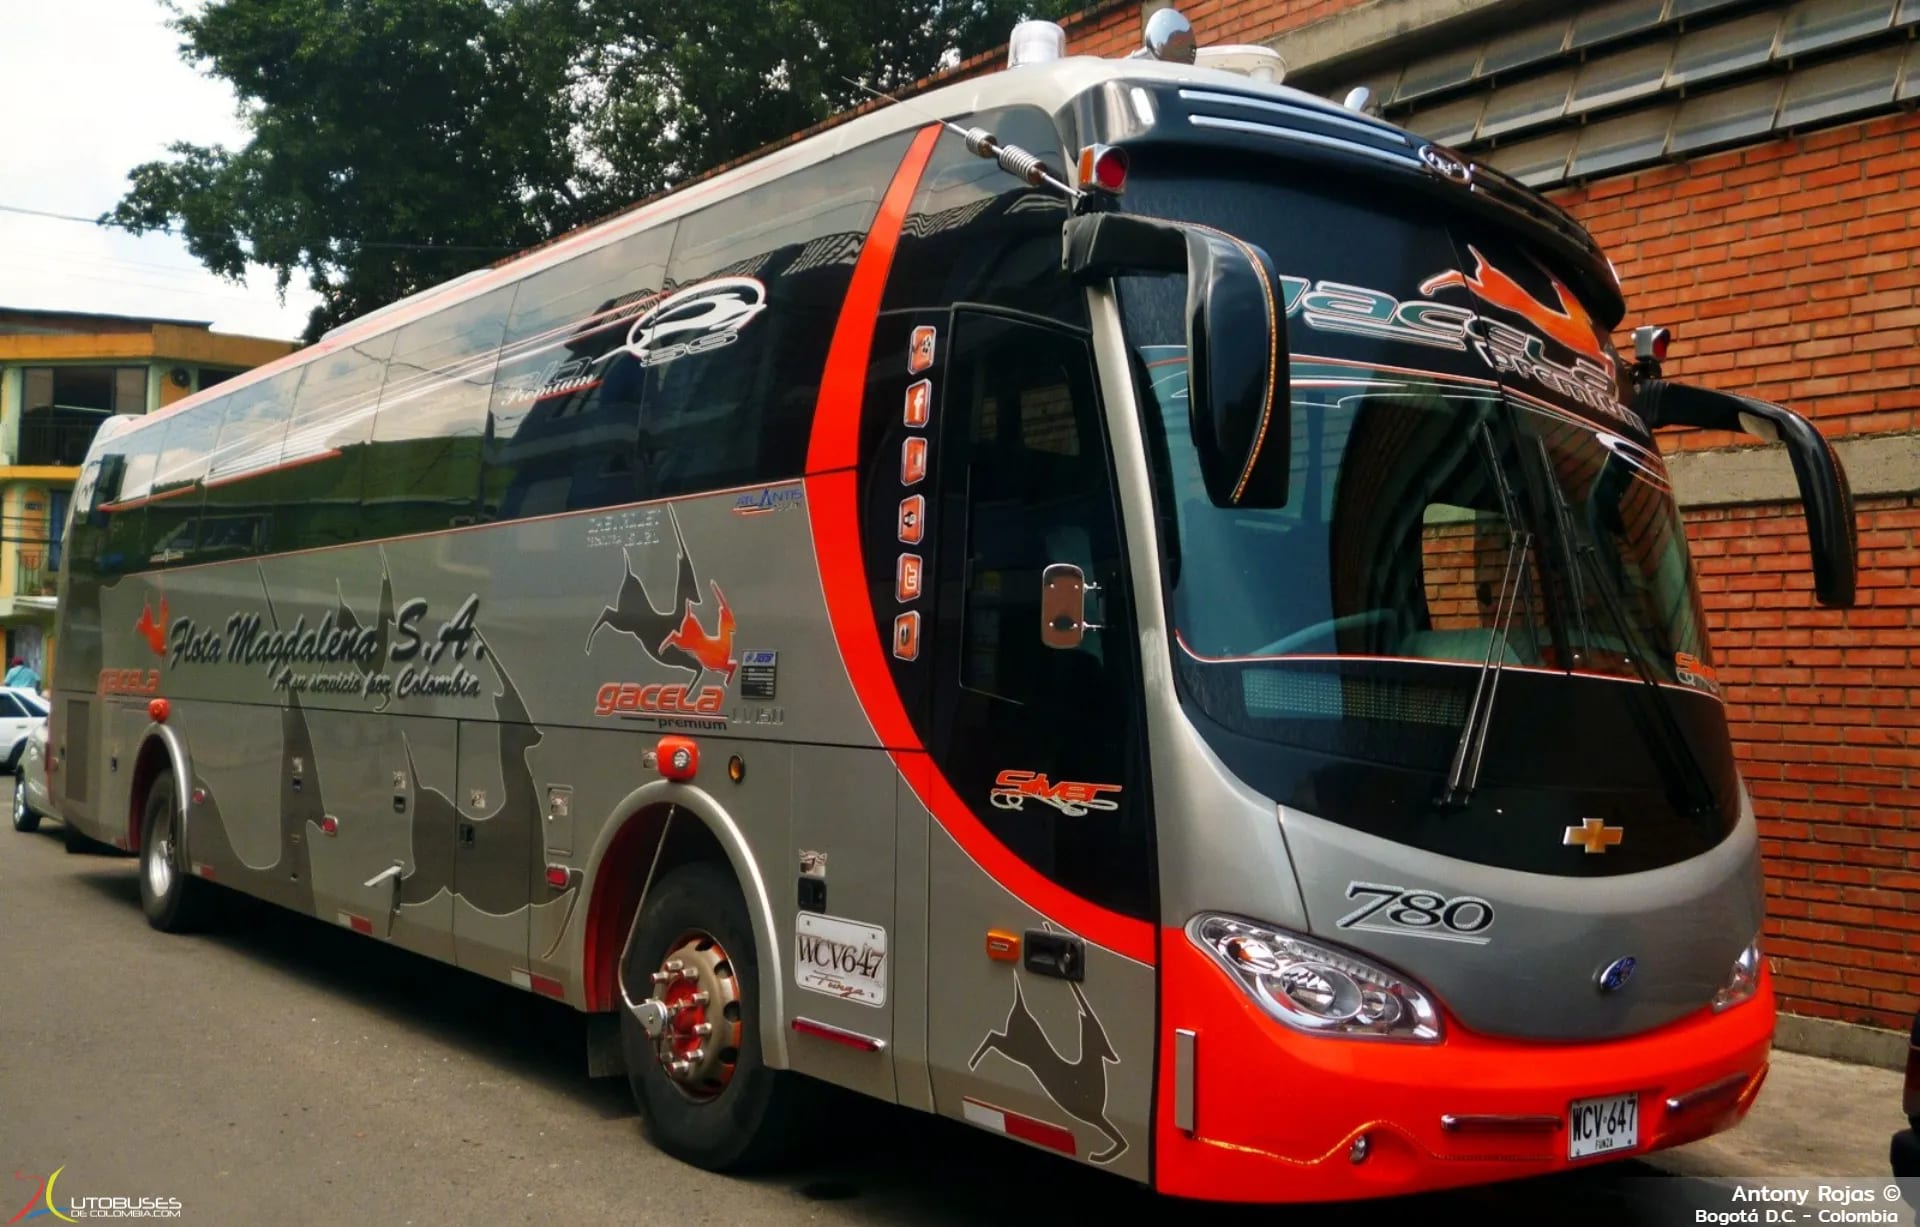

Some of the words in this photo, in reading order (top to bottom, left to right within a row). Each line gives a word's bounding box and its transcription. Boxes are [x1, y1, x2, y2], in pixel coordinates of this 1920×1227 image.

[170, 616, 222, 670] Flota
[226, 611, 378, 679] Magdalena
[308, 671, 362, 693] servicio
[396, 662, 482, 698] Colombia
[658, 715, 728, 732] premium
[1336, 880, 1495, 934] 780
[799, 935, 886, 980] WCV647
